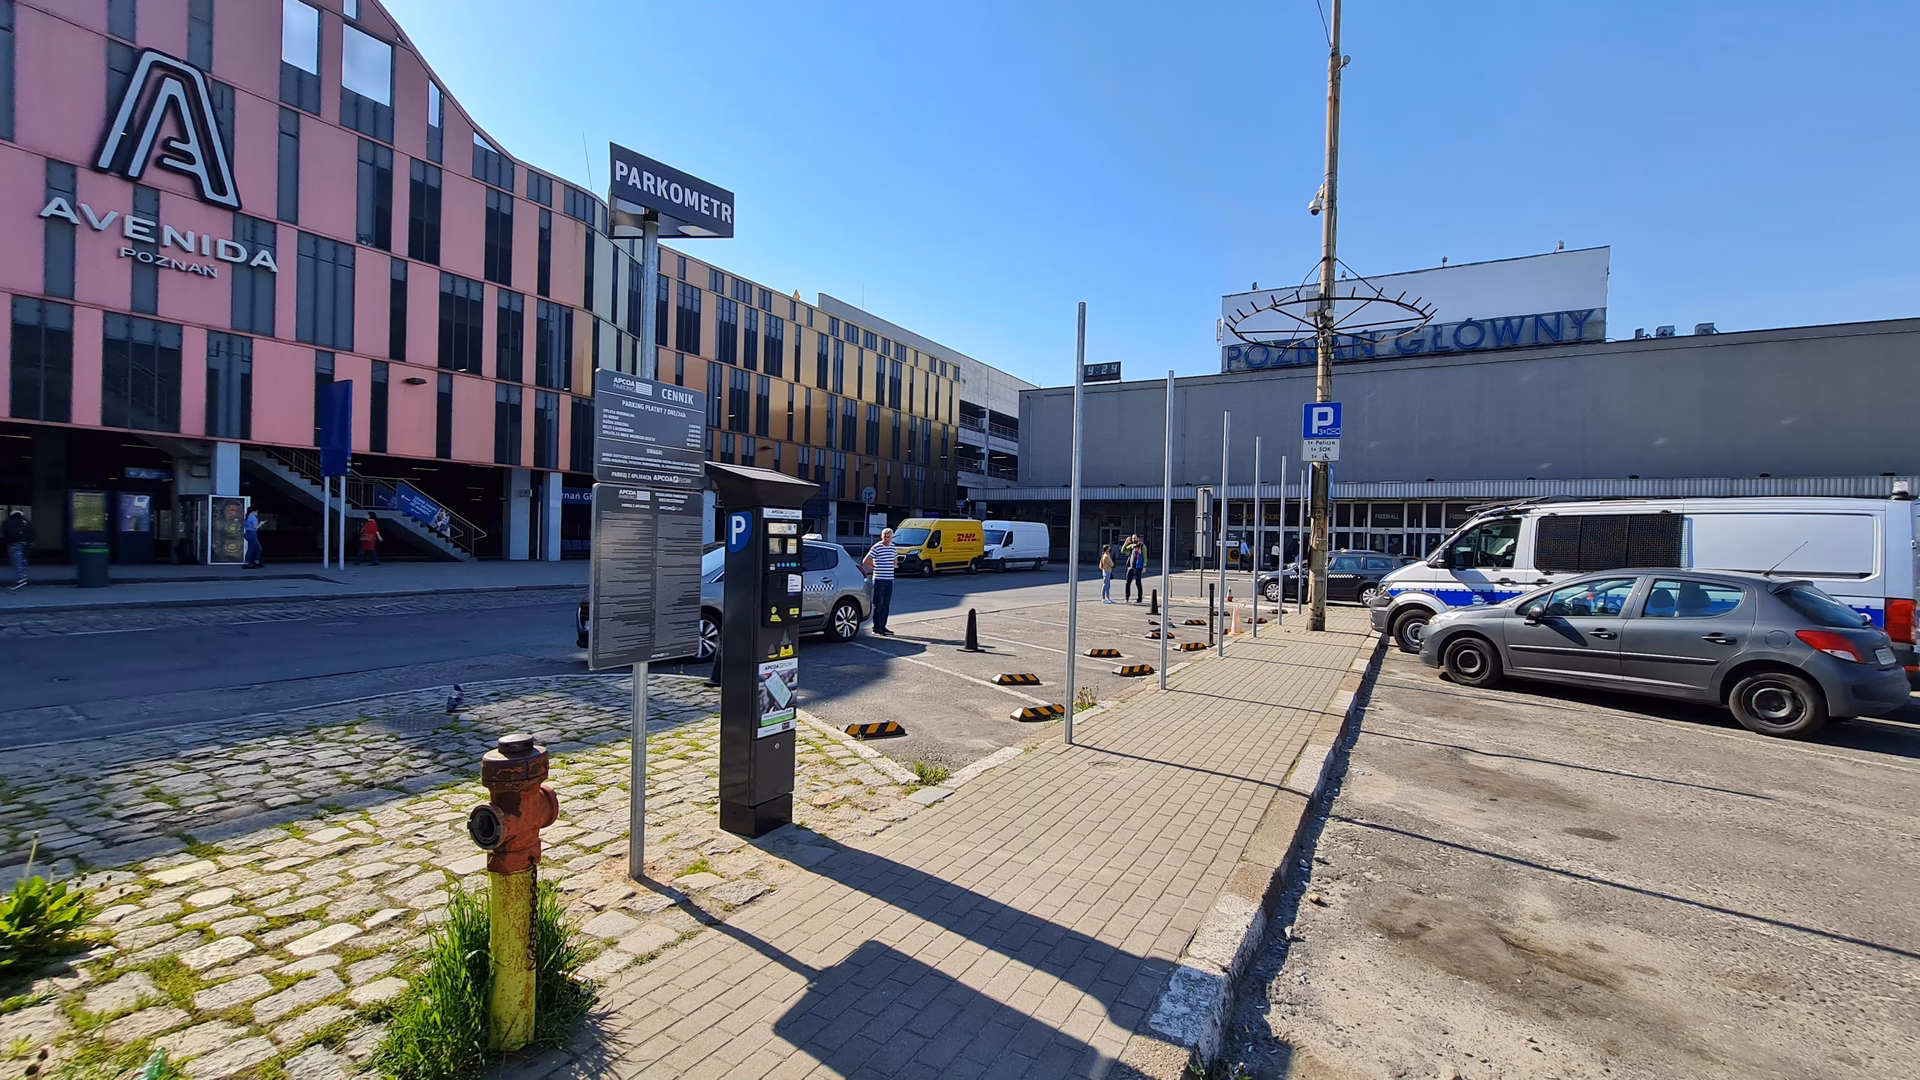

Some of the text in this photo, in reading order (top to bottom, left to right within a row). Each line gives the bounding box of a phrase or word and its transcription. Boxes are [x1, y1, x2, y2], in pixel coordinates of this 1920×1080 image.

[615, 159, 732, 224] PARKOMETR
[39, 196, 279, 273] AVENIDA
[119, 246, 218, 278] POZNAŃ
[1394, 308, 1597, 356] GŁÓWNY
[1087, 364, 1118, 376] 9:24
[612, 383, 636, 393] PARKING
[613, 376, 635, 387] APCOA
[661, 388, 694, 405] CENNIK
[622, 400, 645, 410] PARKING
[645, 404, 663, 414] PŁATNY
[1311, 406, 1334, 435] P
[653, 475, 673, 483] APCOA
[562, 491, 580, 500] znań
[731, 515, 746, 545] P
[957, 533, 976, 542] DHL
[764, 663, 779, 671] APCOA
